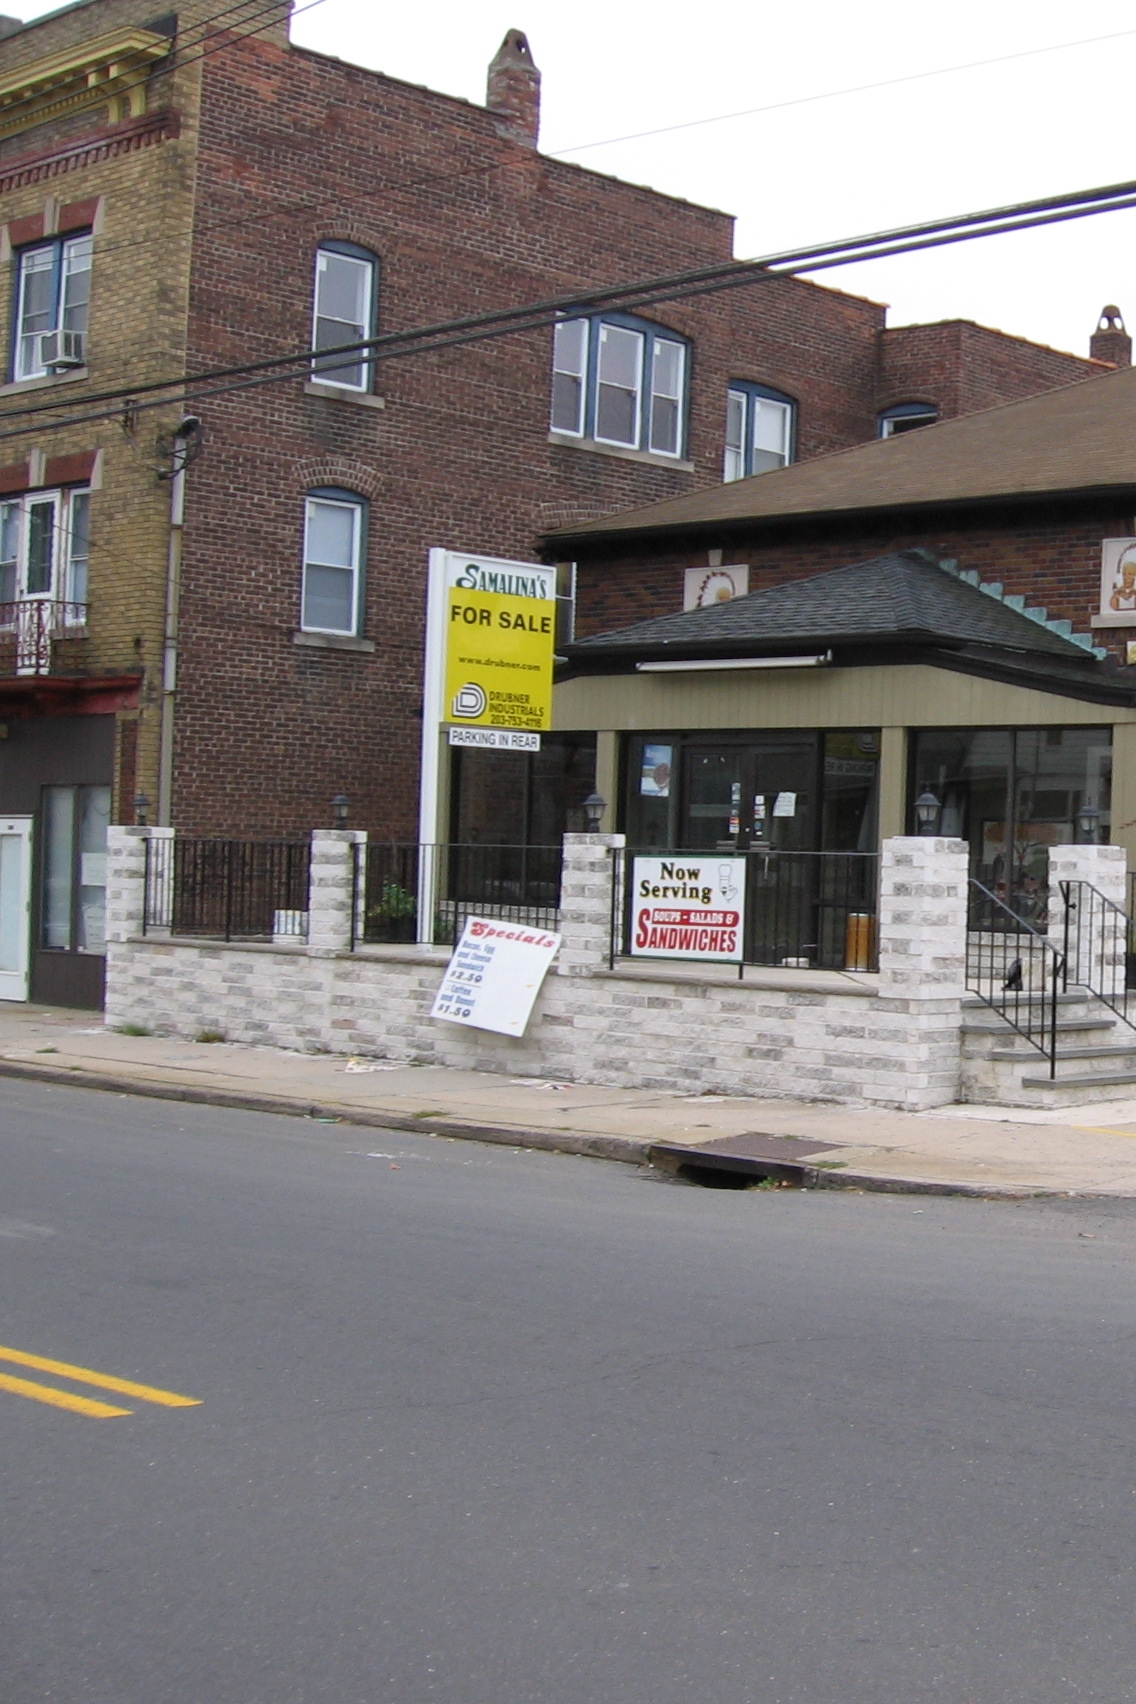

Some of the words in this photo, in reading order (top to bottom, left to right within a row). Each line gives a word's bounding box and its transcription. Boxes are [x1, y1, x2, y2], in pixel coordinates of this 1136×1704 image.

[451, 605, 491, 626] FOR
[498, 611, 551, 633] SALE
[458, 656, 541, 671] www.drubner.com
[489, 691, 530, 704] DRUBNER
[488, 703, 544, 717] INDUSTRIALS
[452, 730, 496, 745] PARKING
[498, 734, 509, 746] IN
[511, 735, 538, 748] REAR
[660, 862, 701, 880] Now
[639, 879, 713, 904] Serving
[653, 910, 682, 923] SOUPS
[689, 911, 723, 924] SALADS
[470, 921, 556, 948] Specials
[635, 908, 737, 953] SANDWICHES
[450, 970, 483, 983] $2.50
[437, 1003, 471, 1018] $1.50
